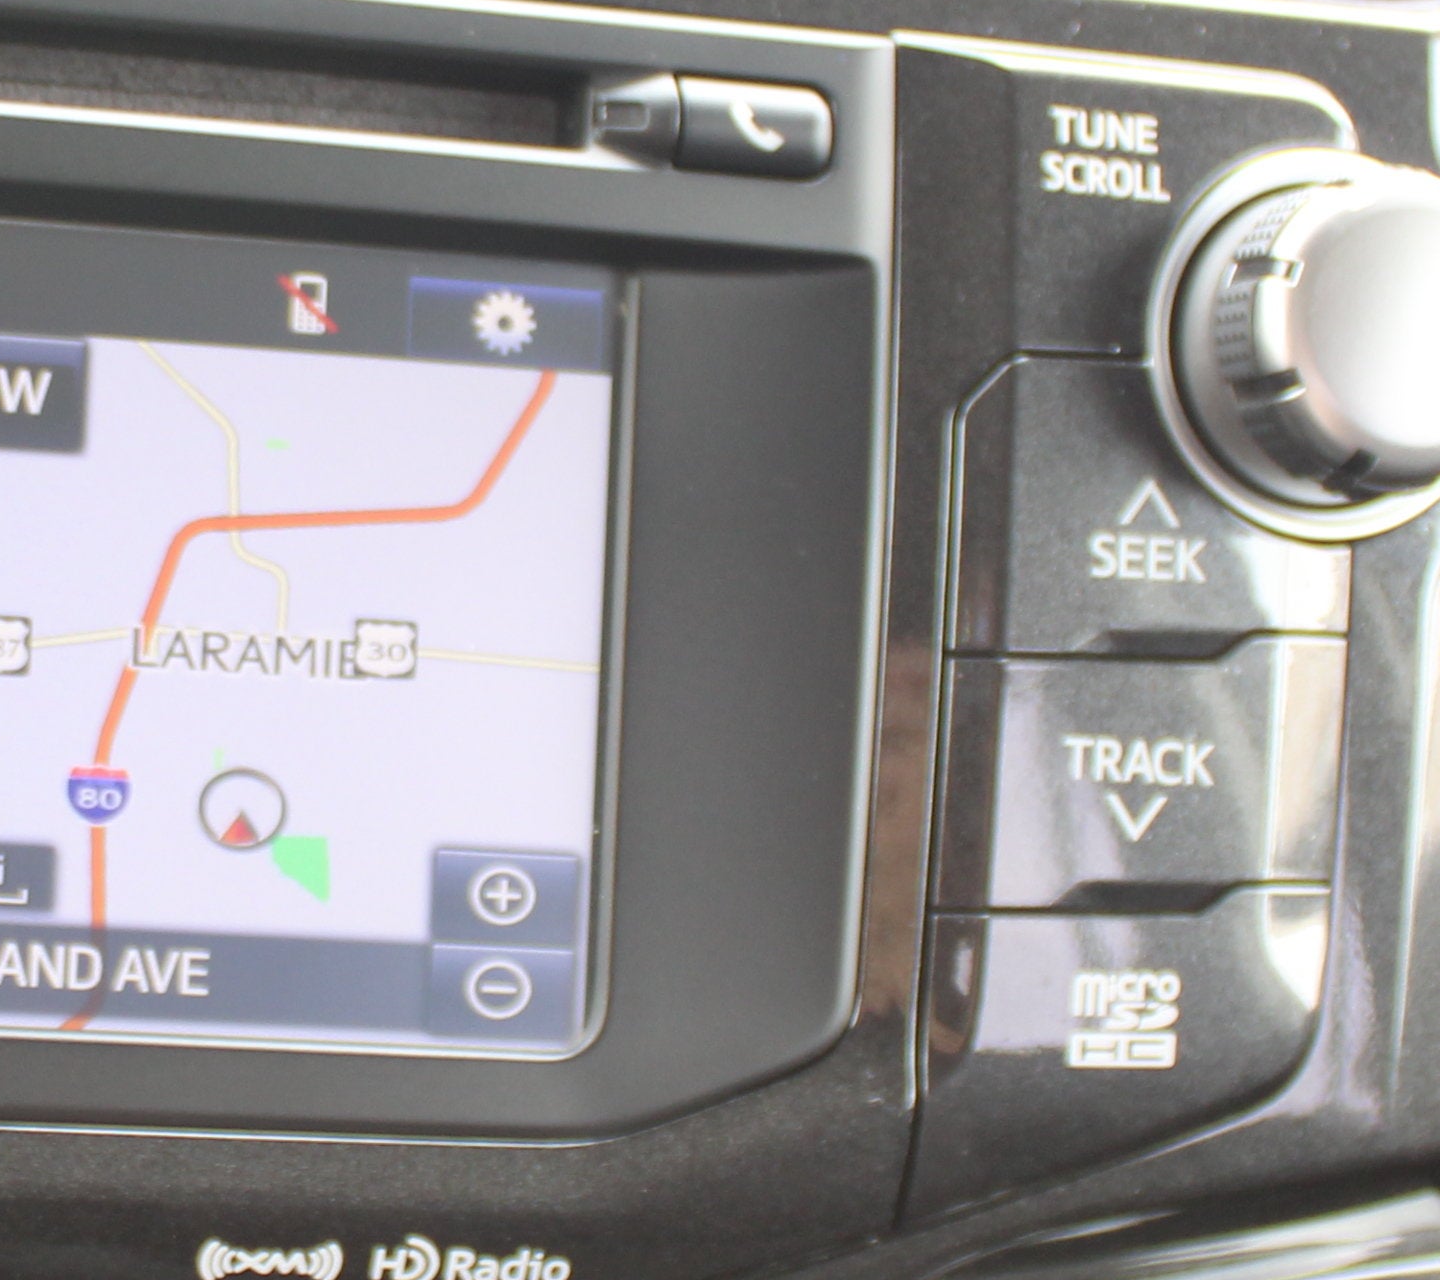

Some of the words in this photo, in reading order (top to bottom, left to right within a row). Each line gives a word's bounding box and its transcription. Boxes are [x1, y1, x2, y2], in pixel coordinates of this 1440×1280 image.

[1047, 103, 1160, 155] TUNE
[1040, 150, 1172, 204] SCROLL
[1088, 531, 1208, 585] SEEK
[366, 640, 408, 662] 30
[1063, 733, 1216, 787] TRACK
[76, 787, 123, 810] 80
[111, 946, 212, 998] AVE
